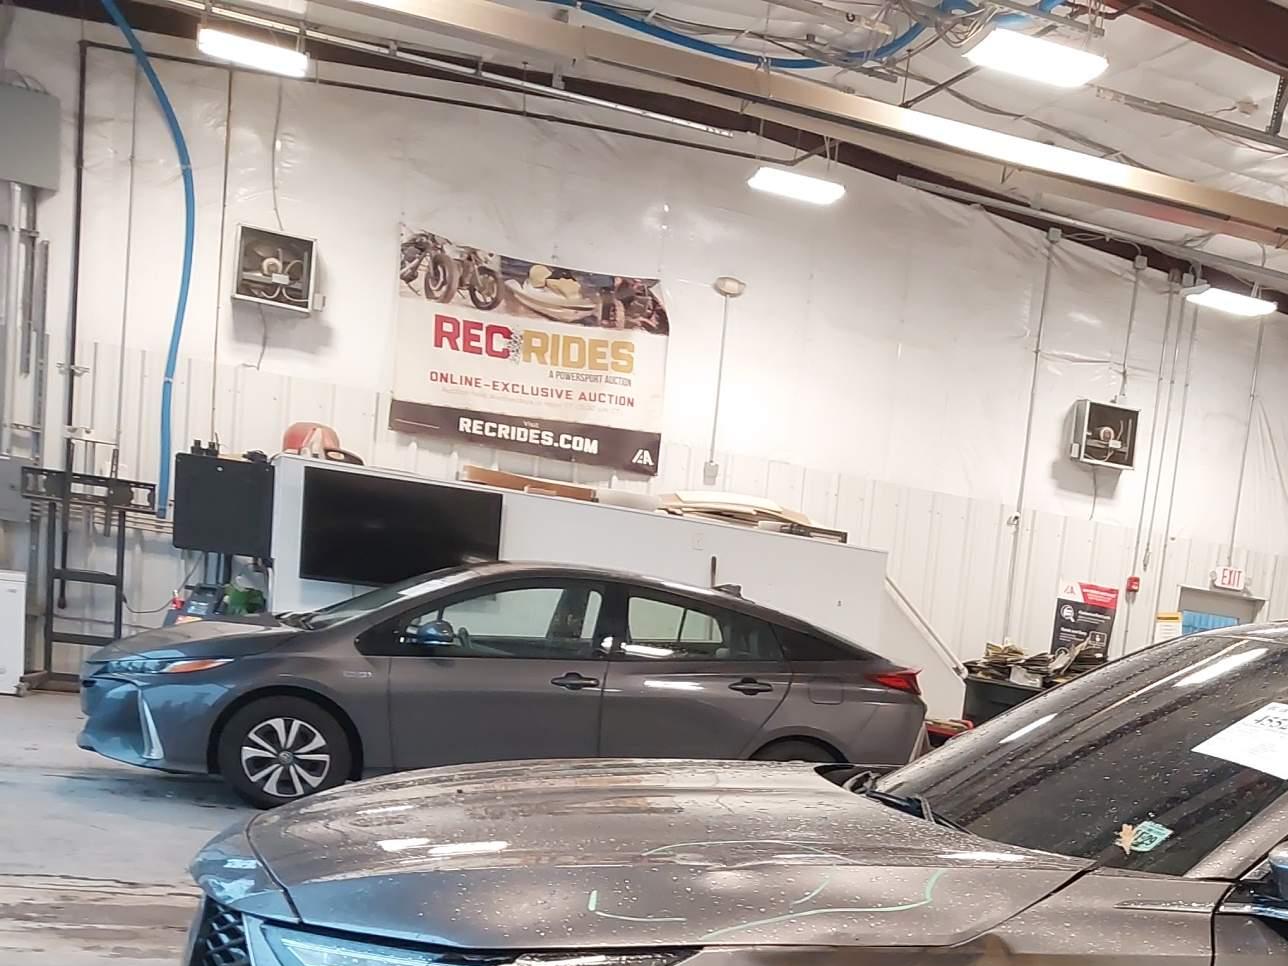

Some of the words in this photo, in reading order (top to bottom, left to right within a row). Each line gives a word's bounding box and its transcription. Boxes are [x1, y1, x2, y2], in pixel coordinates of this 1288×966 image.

[434, 314, 513, 360] REC
[522, 329, 635, 374] RIDES
[429, 371, 573, 400] ONLINE-EXCLUSIVE
[578, 391, 635, 408] AUCTION
[556, 371, 603, 384] POWERSPORT
[604, 375, 631, 387] AUCTION
[458, 416, 599, 454] RECRIDES.COM
[1221, 568, 1242, 587] EXIT
